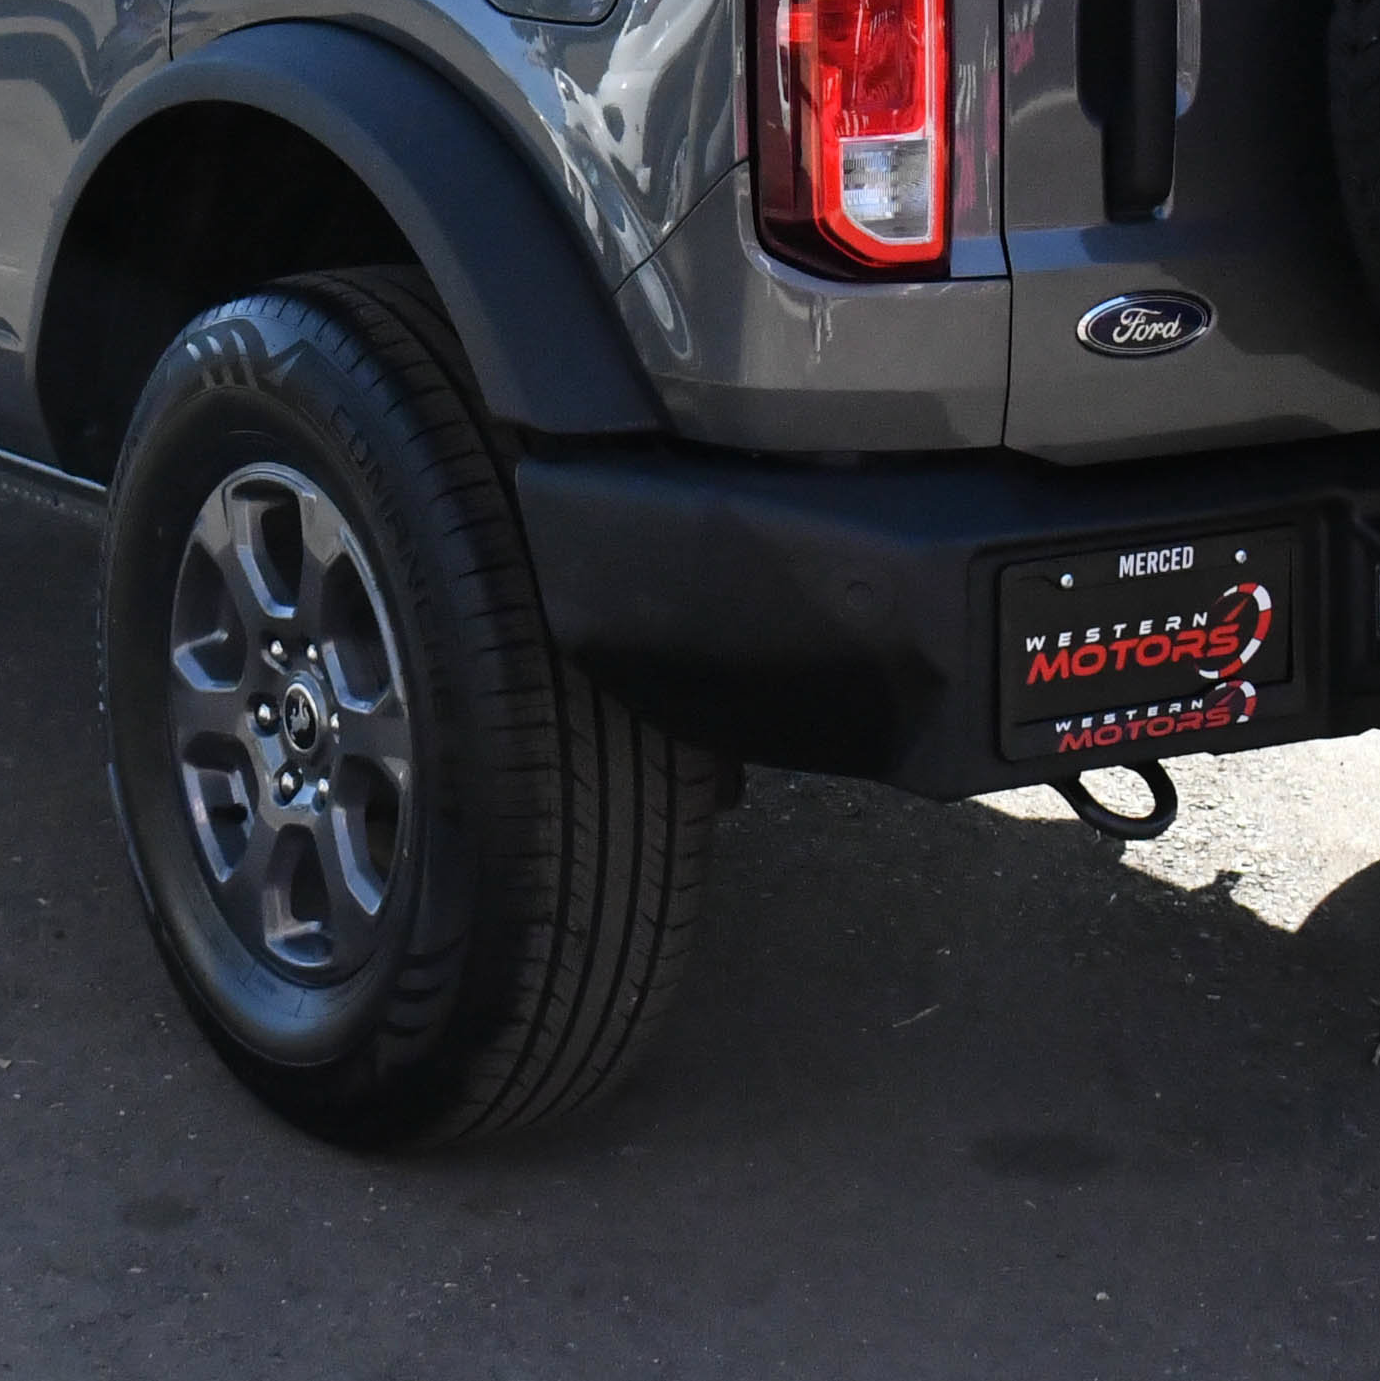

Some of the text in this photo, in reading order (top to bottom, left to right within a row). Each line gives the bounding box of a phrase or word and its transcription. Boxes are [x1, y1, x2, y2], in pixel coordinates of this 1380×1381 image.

[1112, 308, 1182, 343] Ford
[1119, 546, 1194, 578] MERCED
[1026, 613, 1208, 652] WESTERN
[1027, 623, 1239, 684] MOTORS
[1056, 699, 1203, 732] WESTERN
[1059, 707, 1231, 752] MOTORS
